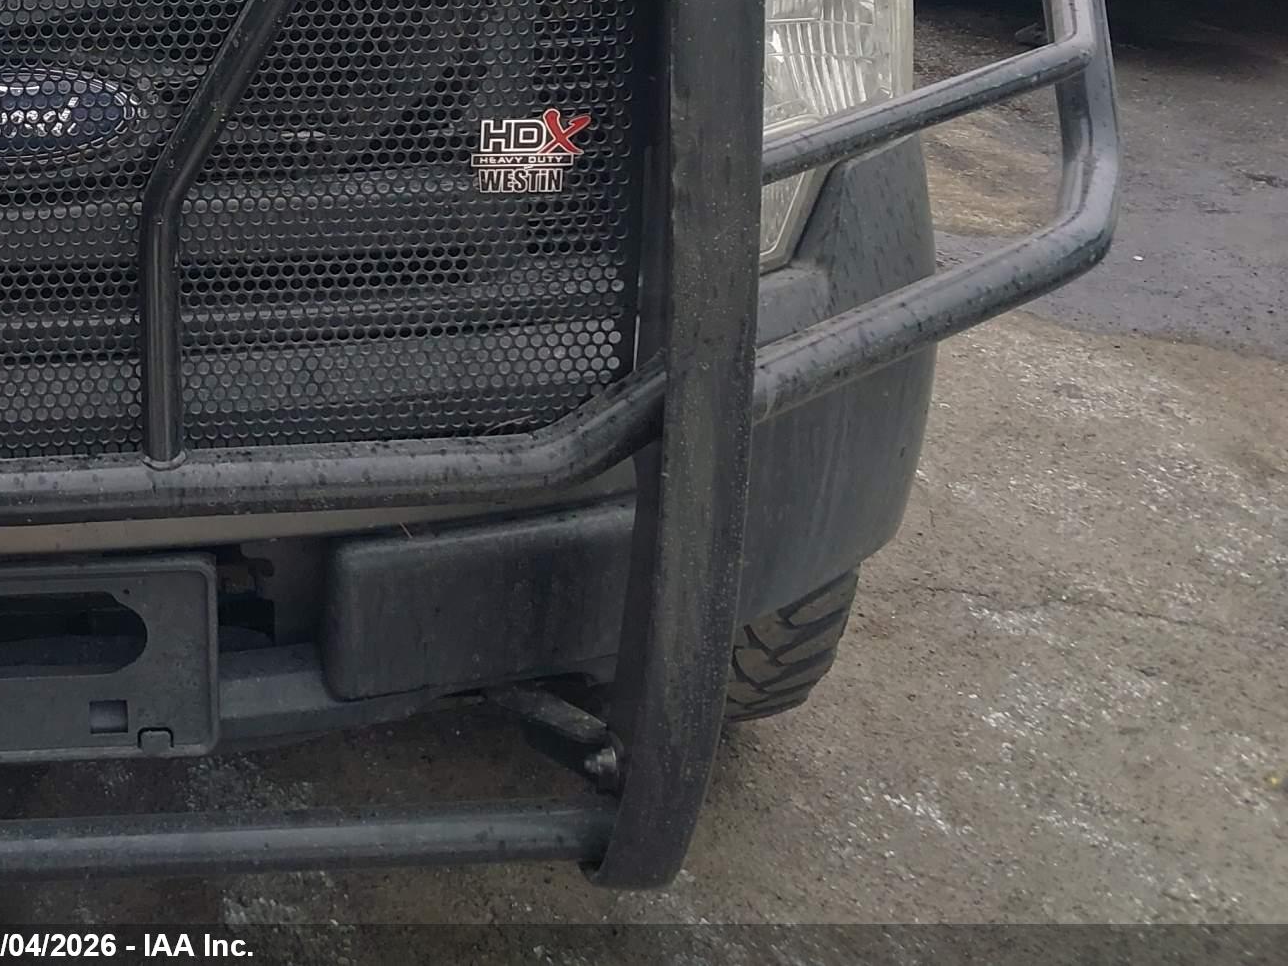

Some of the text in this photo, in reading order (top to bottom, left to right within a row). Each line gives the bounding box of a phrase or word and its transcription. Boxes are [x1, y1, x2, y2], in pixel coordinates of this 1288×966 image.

[480, 108, 592, 154] HDX
[479, 155, 563, 164] HEAVY DUTY
